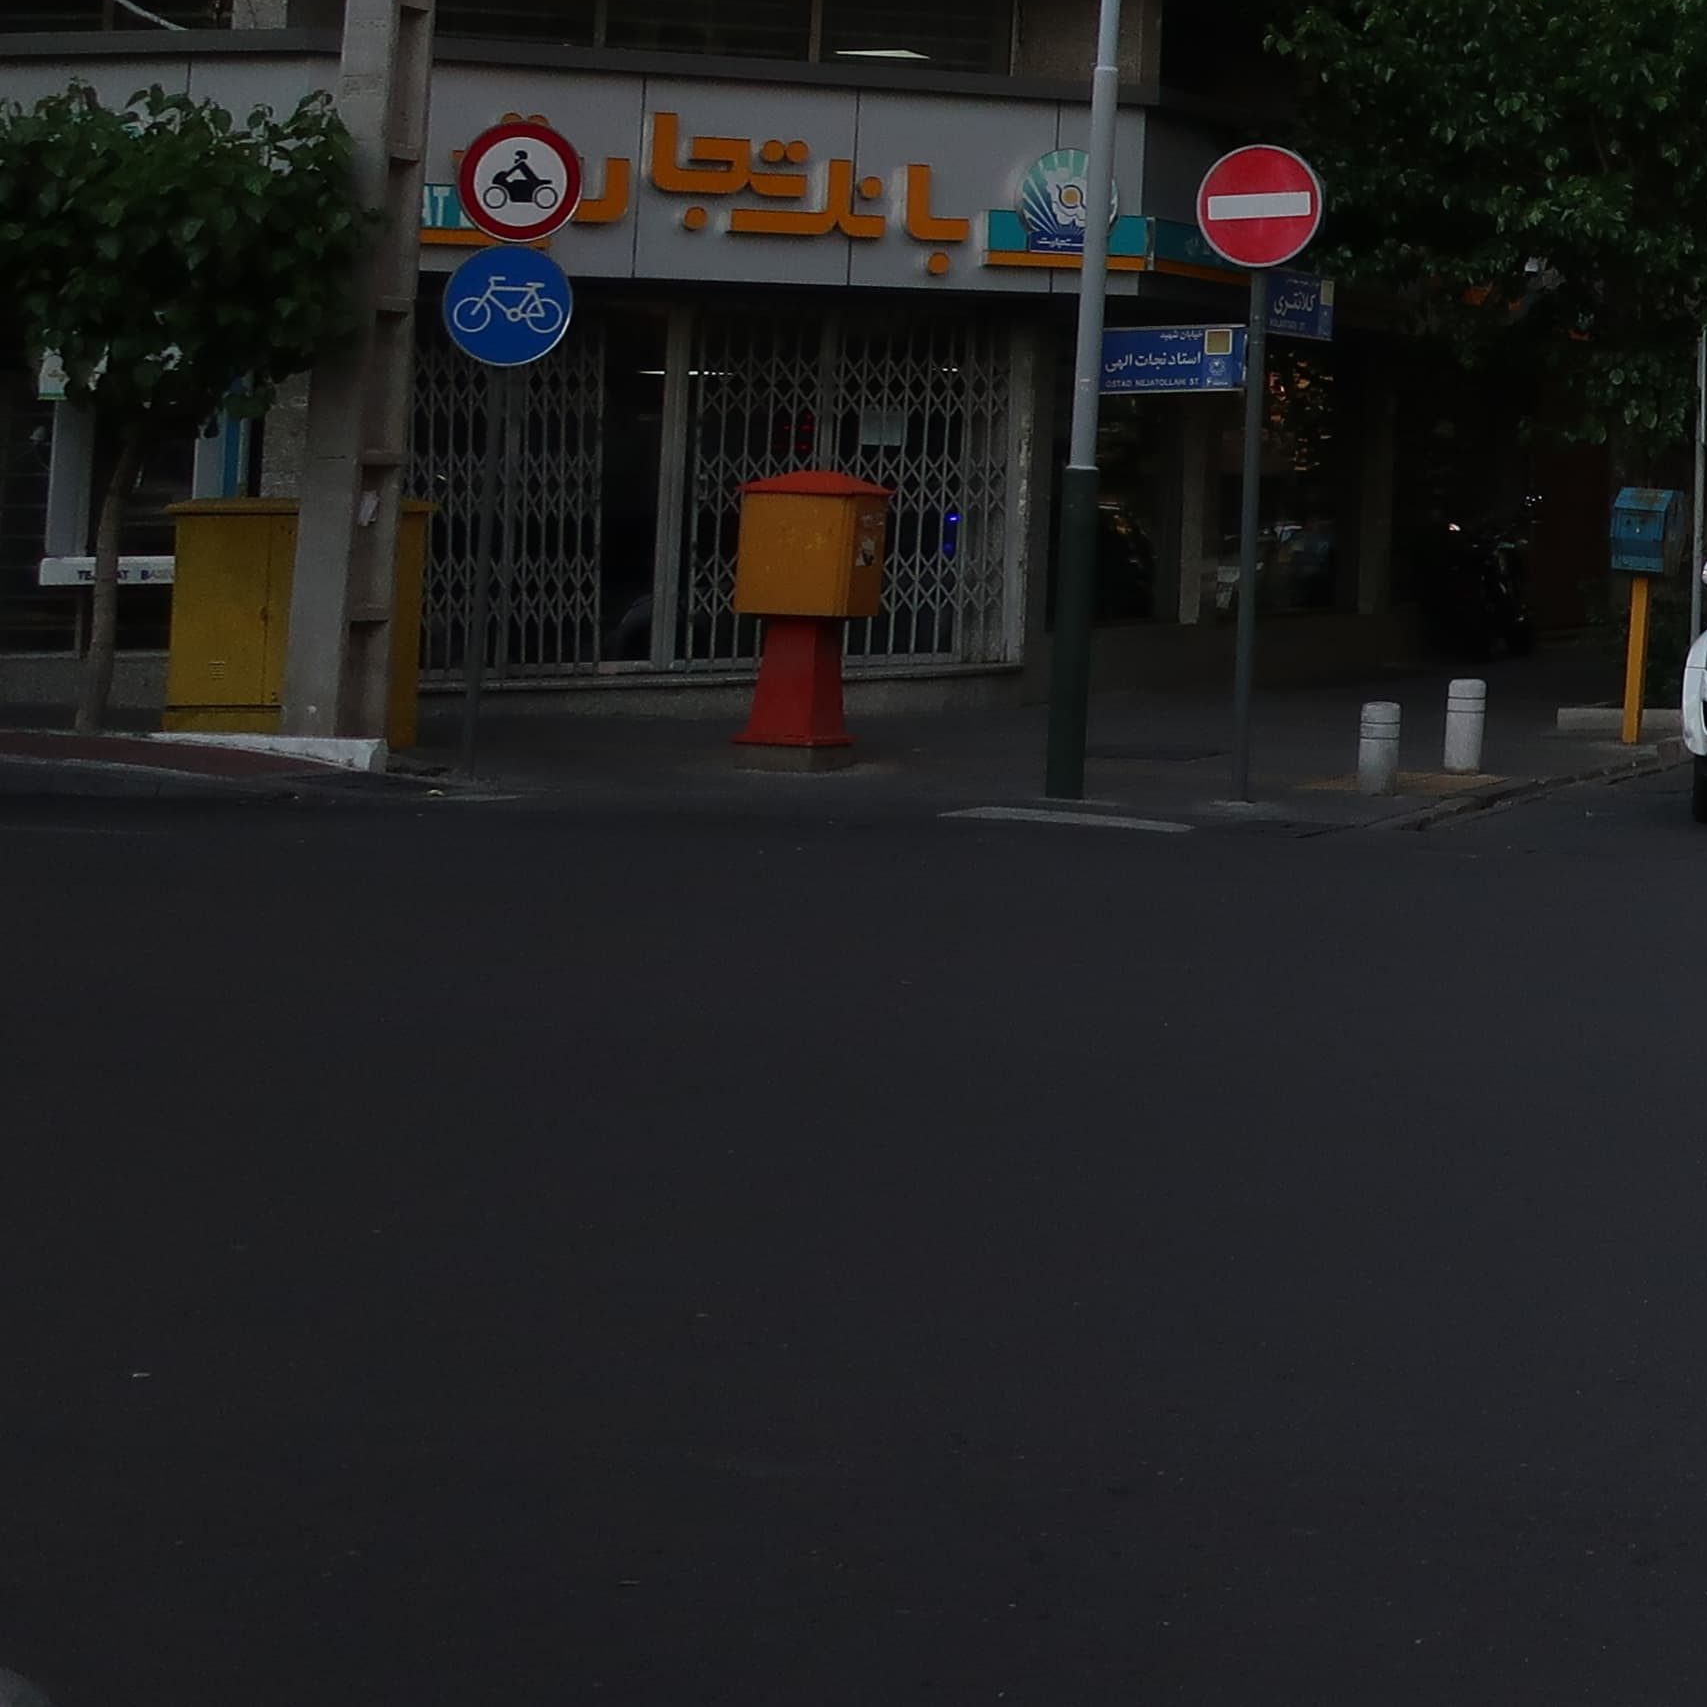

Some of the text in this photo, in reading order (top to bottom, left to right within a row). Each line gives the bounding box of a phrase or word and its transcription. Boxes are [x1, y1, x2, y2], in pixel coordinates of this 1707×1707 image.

[452, 111, 970, 276] بانک تجار
[1273, 291, 1317, 316] کلانتری
[1159, 329, 1203, 342] خیابان شهید
[1104, 350, 1202, 373] استاد نجات الهی
